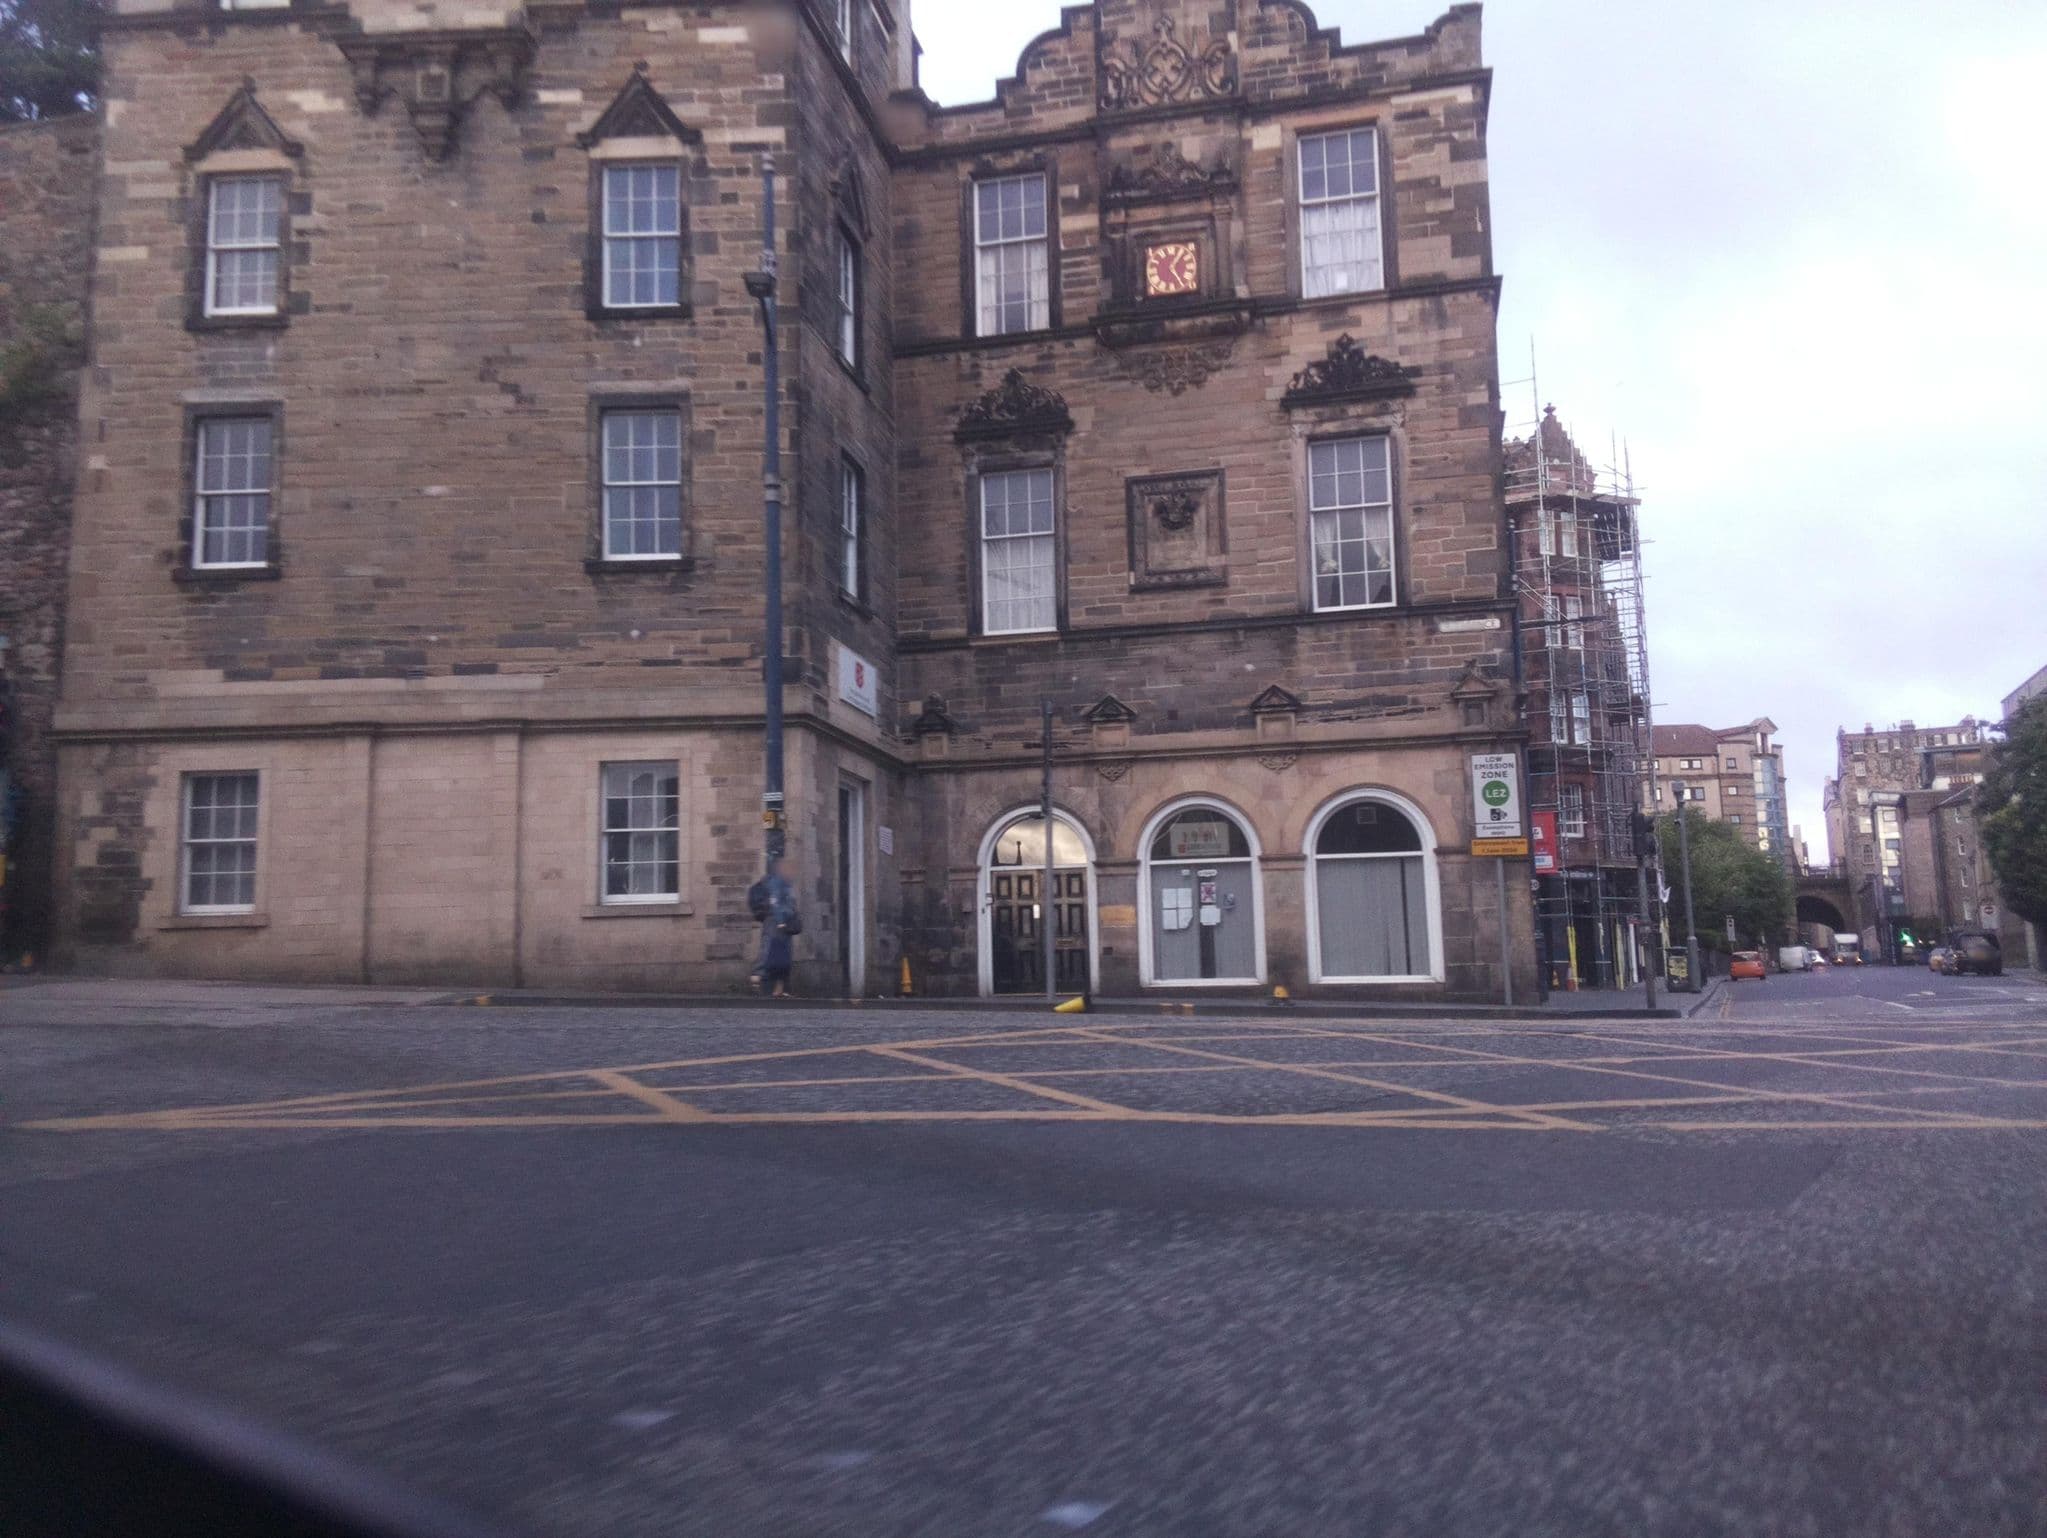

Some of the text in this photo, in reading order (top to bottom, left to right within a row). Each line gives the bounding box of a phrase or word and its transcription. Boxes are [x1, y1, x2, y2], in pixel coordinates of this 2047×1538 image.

[1474, 762, 1514, 770] EMISSION
[1481, 771, 1509, 779] ZONE
[1485, 789, 1507, 798] LEZ
